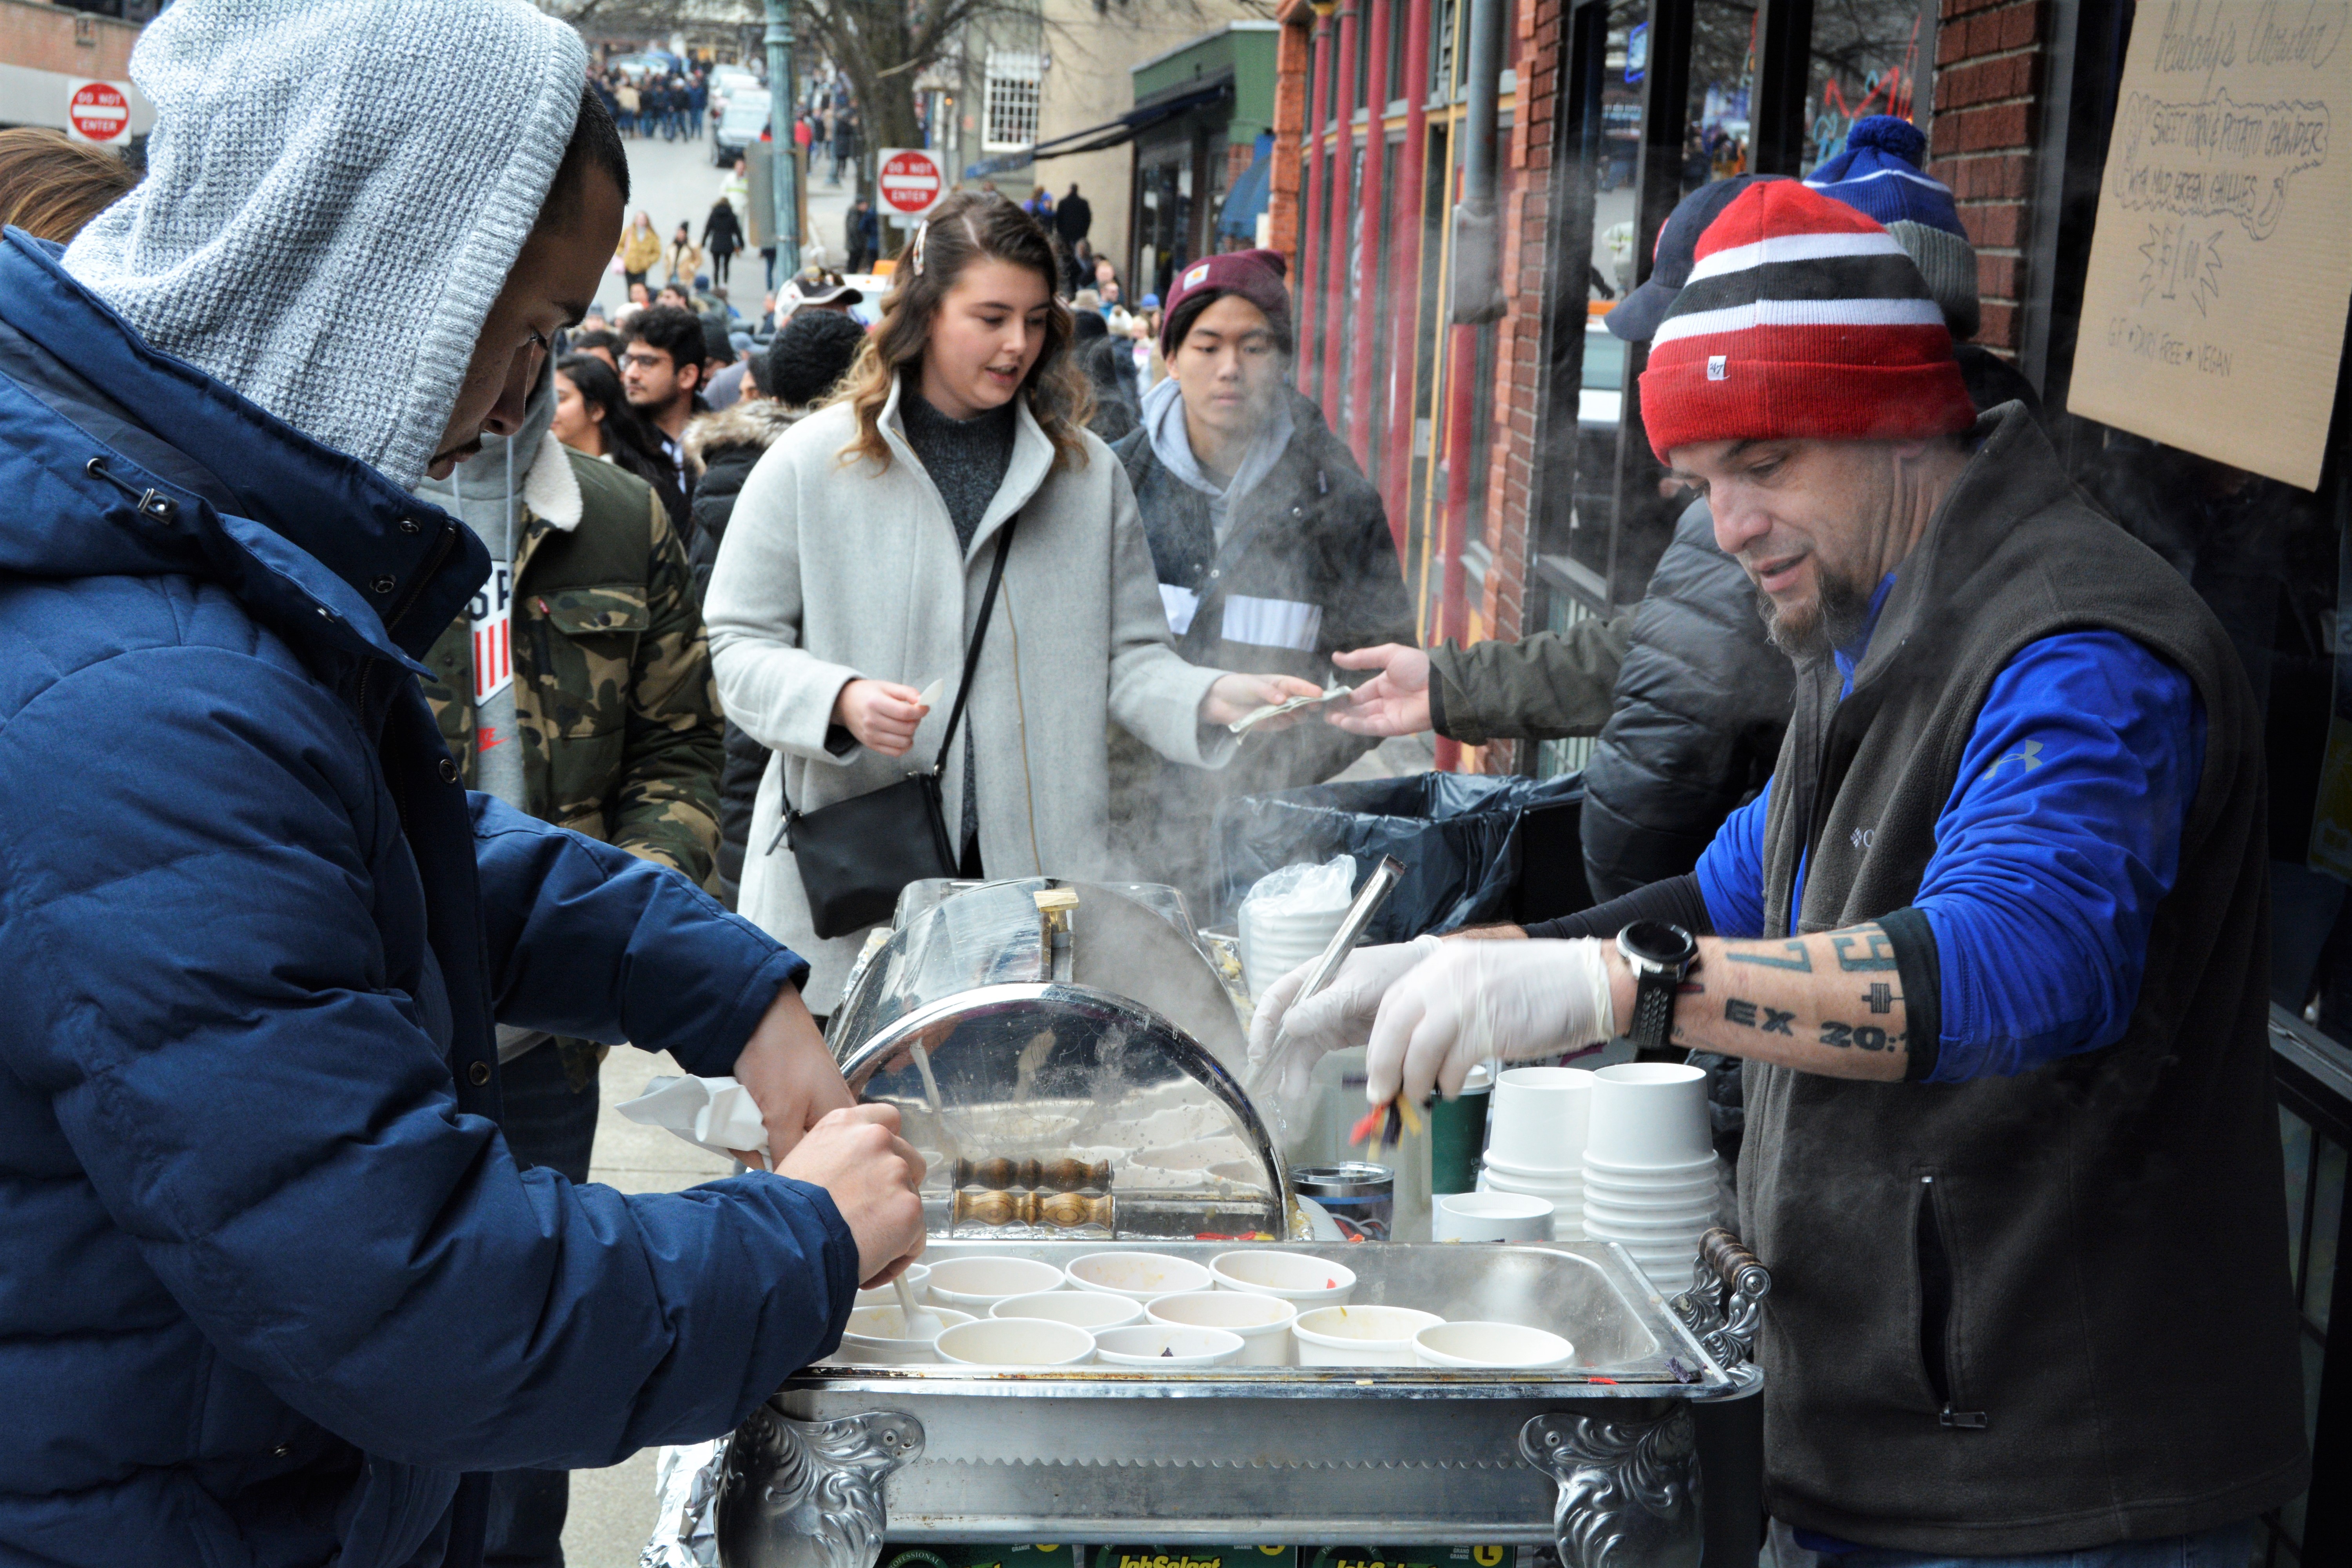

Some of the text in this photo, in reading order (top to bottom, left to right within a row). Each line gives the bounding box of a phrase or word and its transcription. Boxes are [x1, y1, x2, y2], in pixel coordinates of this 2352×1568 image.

[77, 92, 120, 105] DO NOT
[81, 119, 117, 132] ENTER
[2151, 111, 2187, 146] SWEET
[2219, 112, 2263, 159] POTATO
[2265, 115, 2325, 158] CHOWDER
[887, 162, 932, 174] DO NOT
[2174, 171, 2207, 205] GREEN
[891, 190, 928, 203] ENTER
[2197, 341, 2233, 377] VEGAN
[1725, 998, 1796, 1036] EX
[889, 1552, 939, 1568] OFESSIONAL
[1482, 1546, 1494, 1560] L
